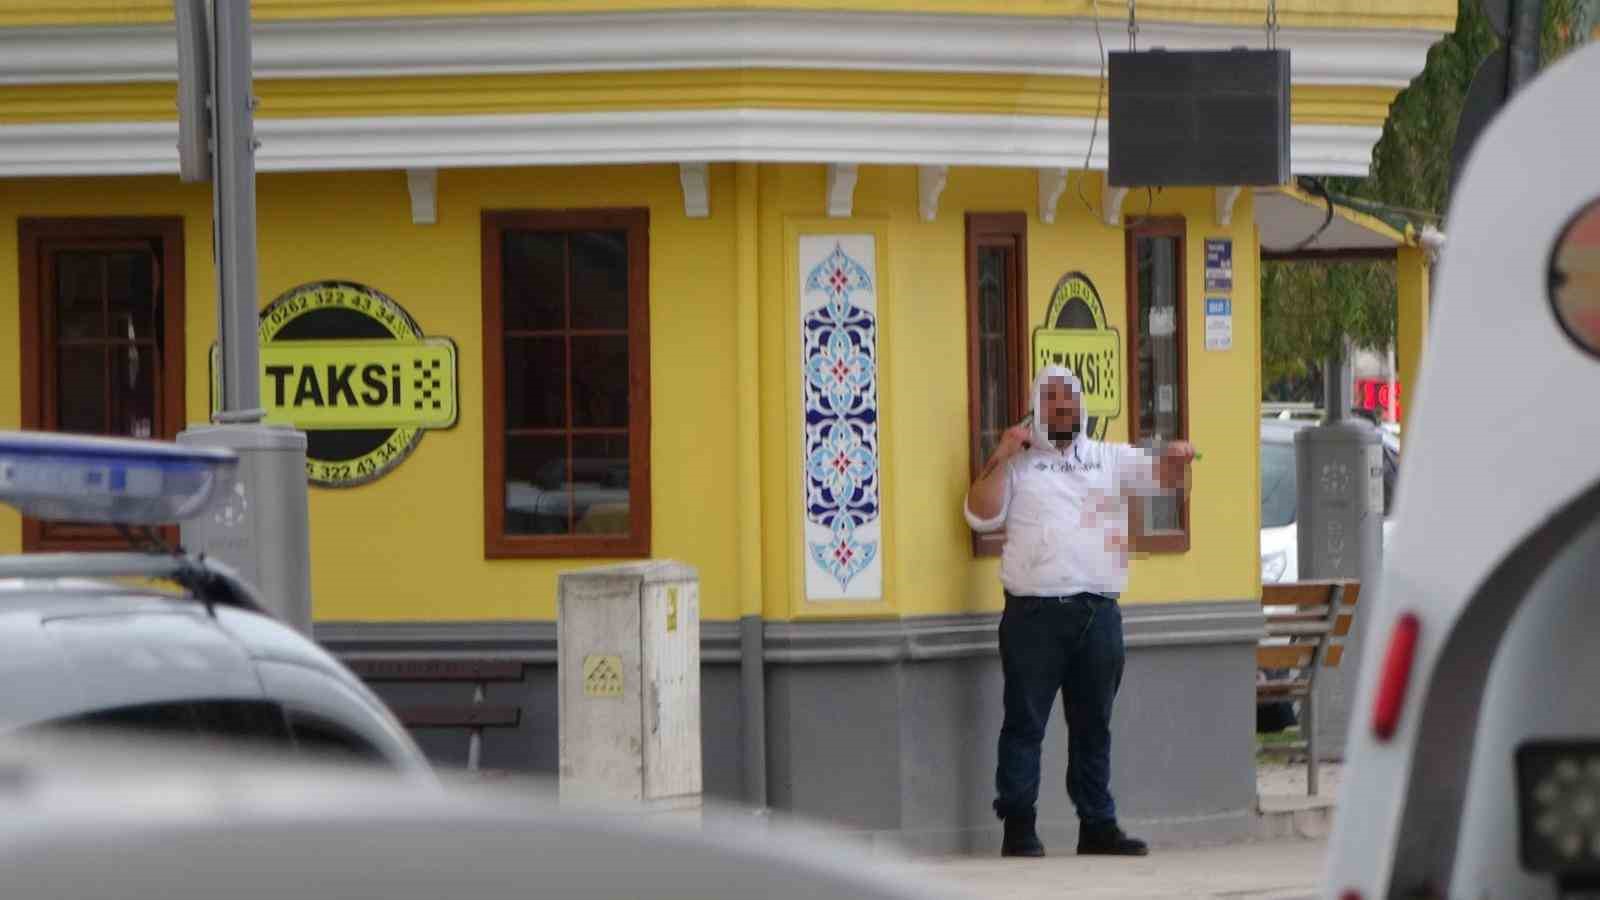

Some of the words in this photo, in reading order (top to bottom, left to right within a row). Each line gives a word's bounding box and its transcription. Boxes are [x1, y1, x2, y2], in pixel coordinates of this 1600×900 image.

[271, 296, 307, 324] 0262
[314, 290, 345, 304] 322
[352, 295, 372, 311] 43
[376, 305, 396, 324] 34
[265, 364, 401, 408] TAKSi
[321, 464, 353, 479] 322
[356, 457, 377, 475] 43
[376, 443, 397, 462] 34
